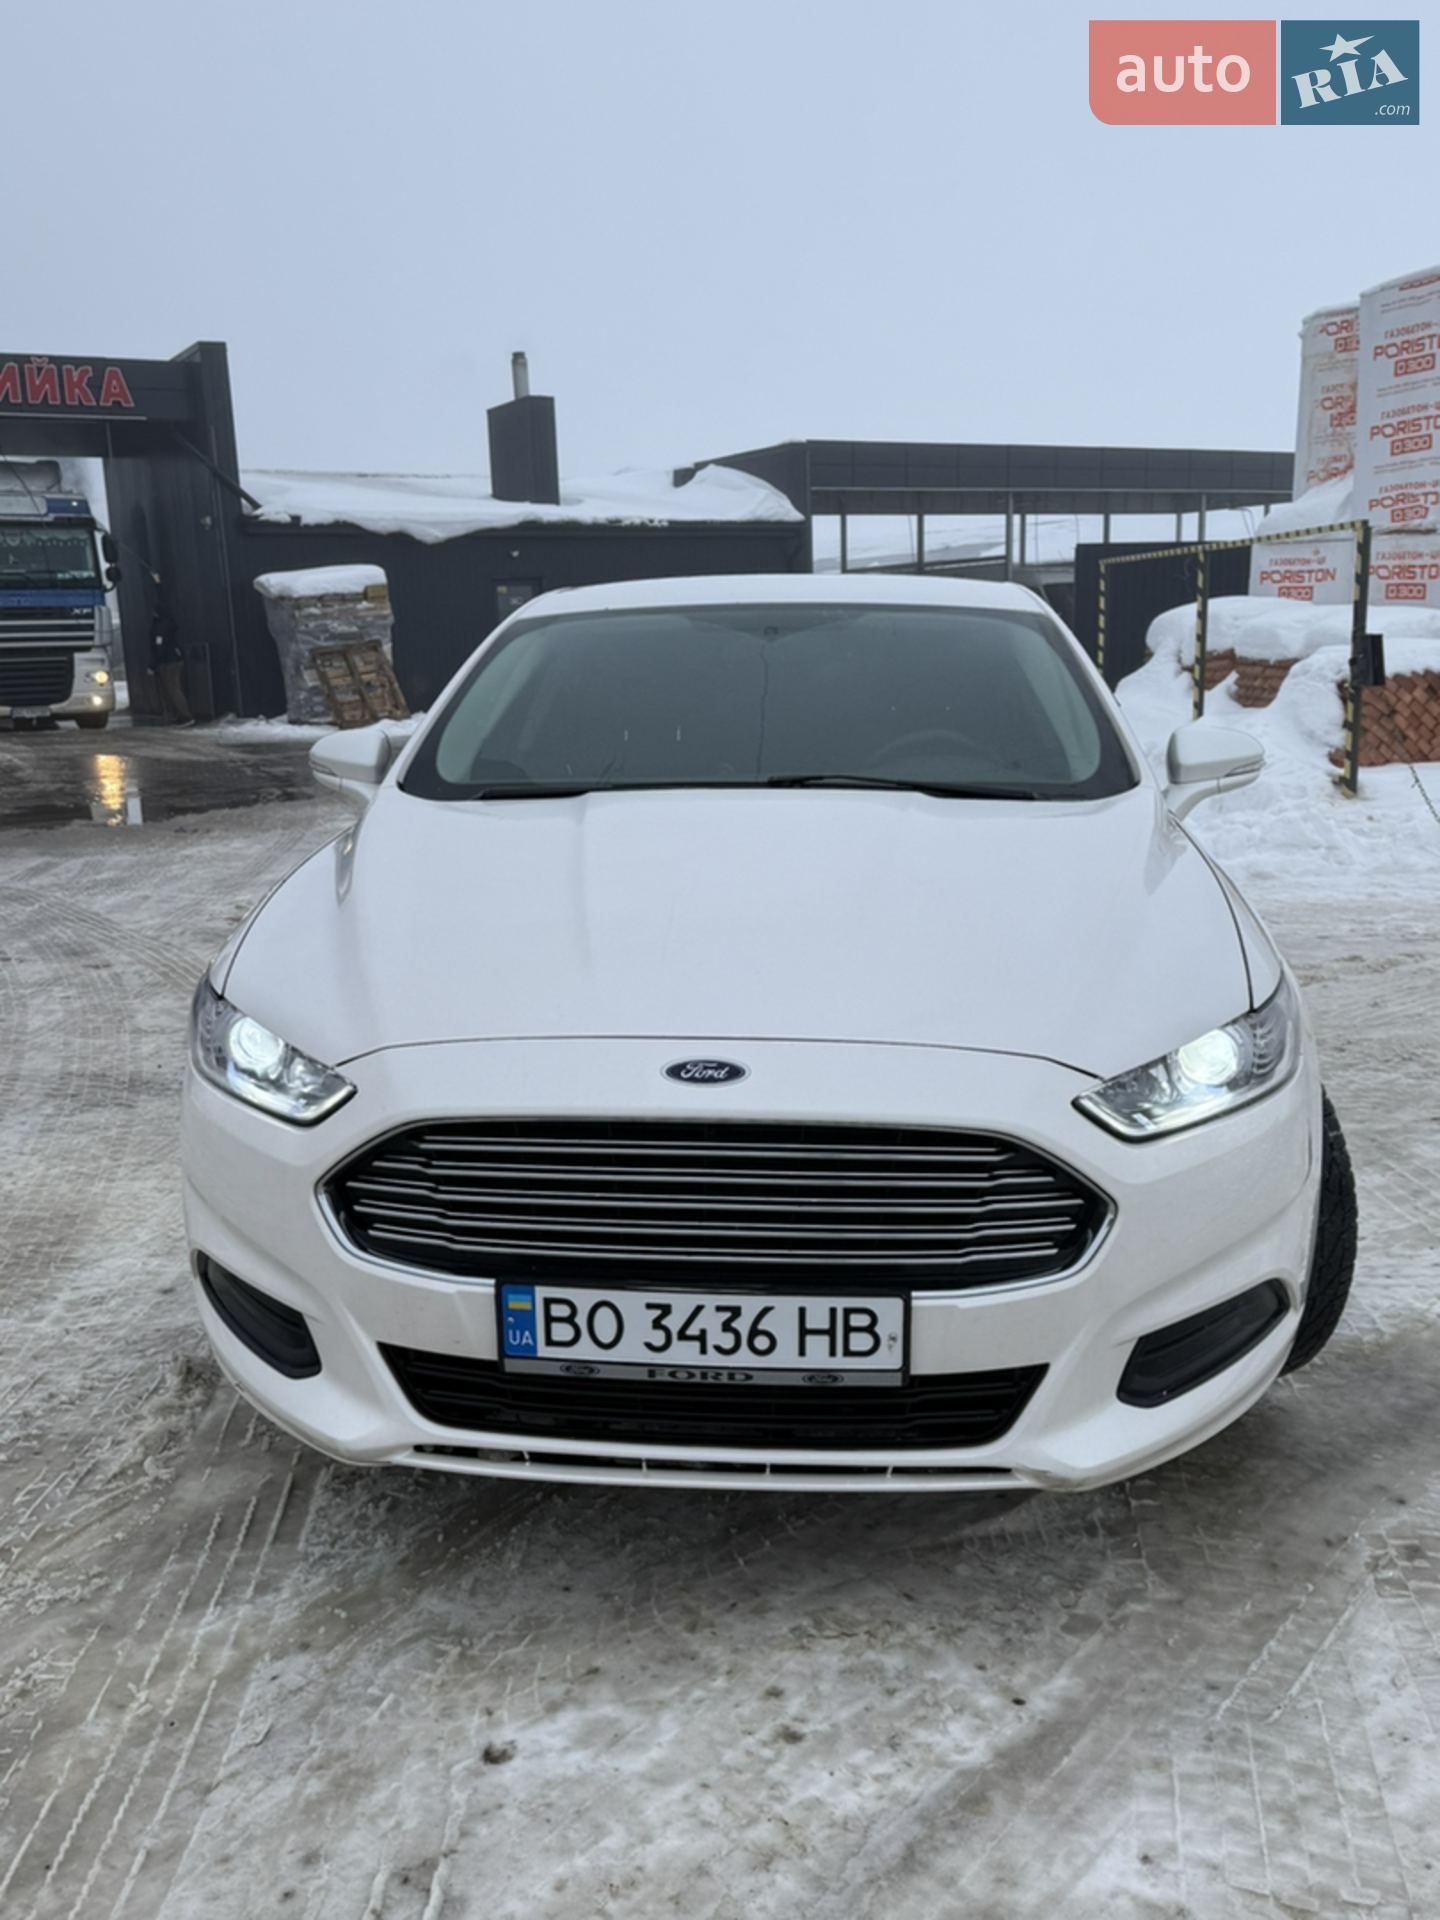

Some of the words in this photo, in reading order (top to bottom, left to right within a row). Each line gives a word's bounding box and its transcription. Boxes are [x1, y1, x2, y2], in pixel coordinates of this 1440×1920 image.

[1259, 567, 1337, 586] PORISTON
[680, 1062, 730, 1080] Ford
[542, 1297, 625, 1350] BO
[643, 1302, 778, 1357] 3436
[798, 1306, 882, 1358] HB
[508, 1330, 534, 1346] UA
[648, 1368, 754, 1382] FORD
